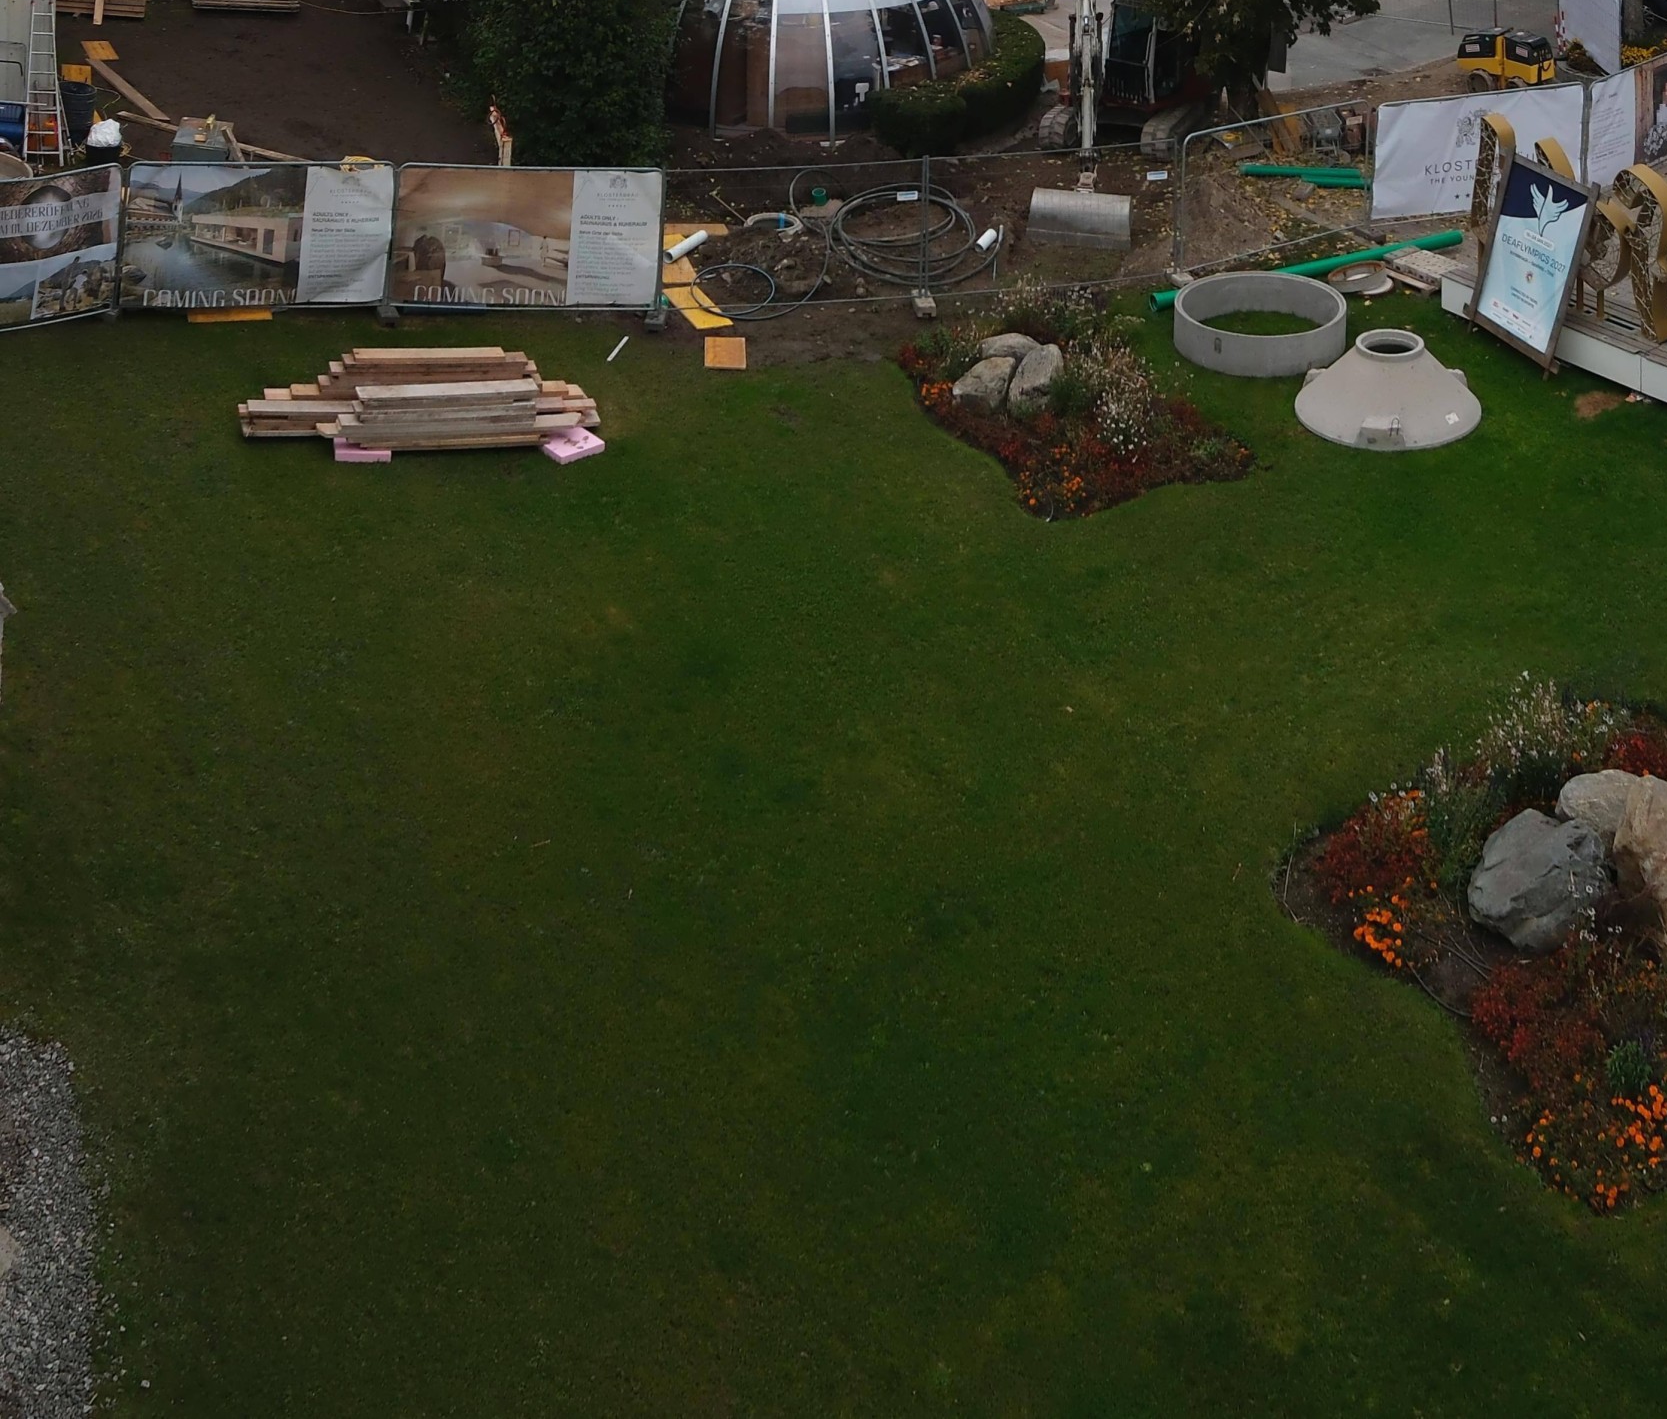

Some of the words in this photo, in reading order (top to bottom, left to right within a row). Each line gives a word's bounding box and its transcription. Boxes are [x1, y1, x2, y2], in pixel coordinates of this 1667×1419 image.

[1430, 177, 1446, 185] THE
[1450, 174, 1475, 182] YOUN
[1501, 232, 1551, 265] DEAFLYMPICS
[1549, 258, 1566, 273] 2027
[143, 288, 226, 308] COMING
[231, 287, 298, 307] SOON!
[414, 284, 495, 305] COMING
[500, 286, 566, 306] SOON!
